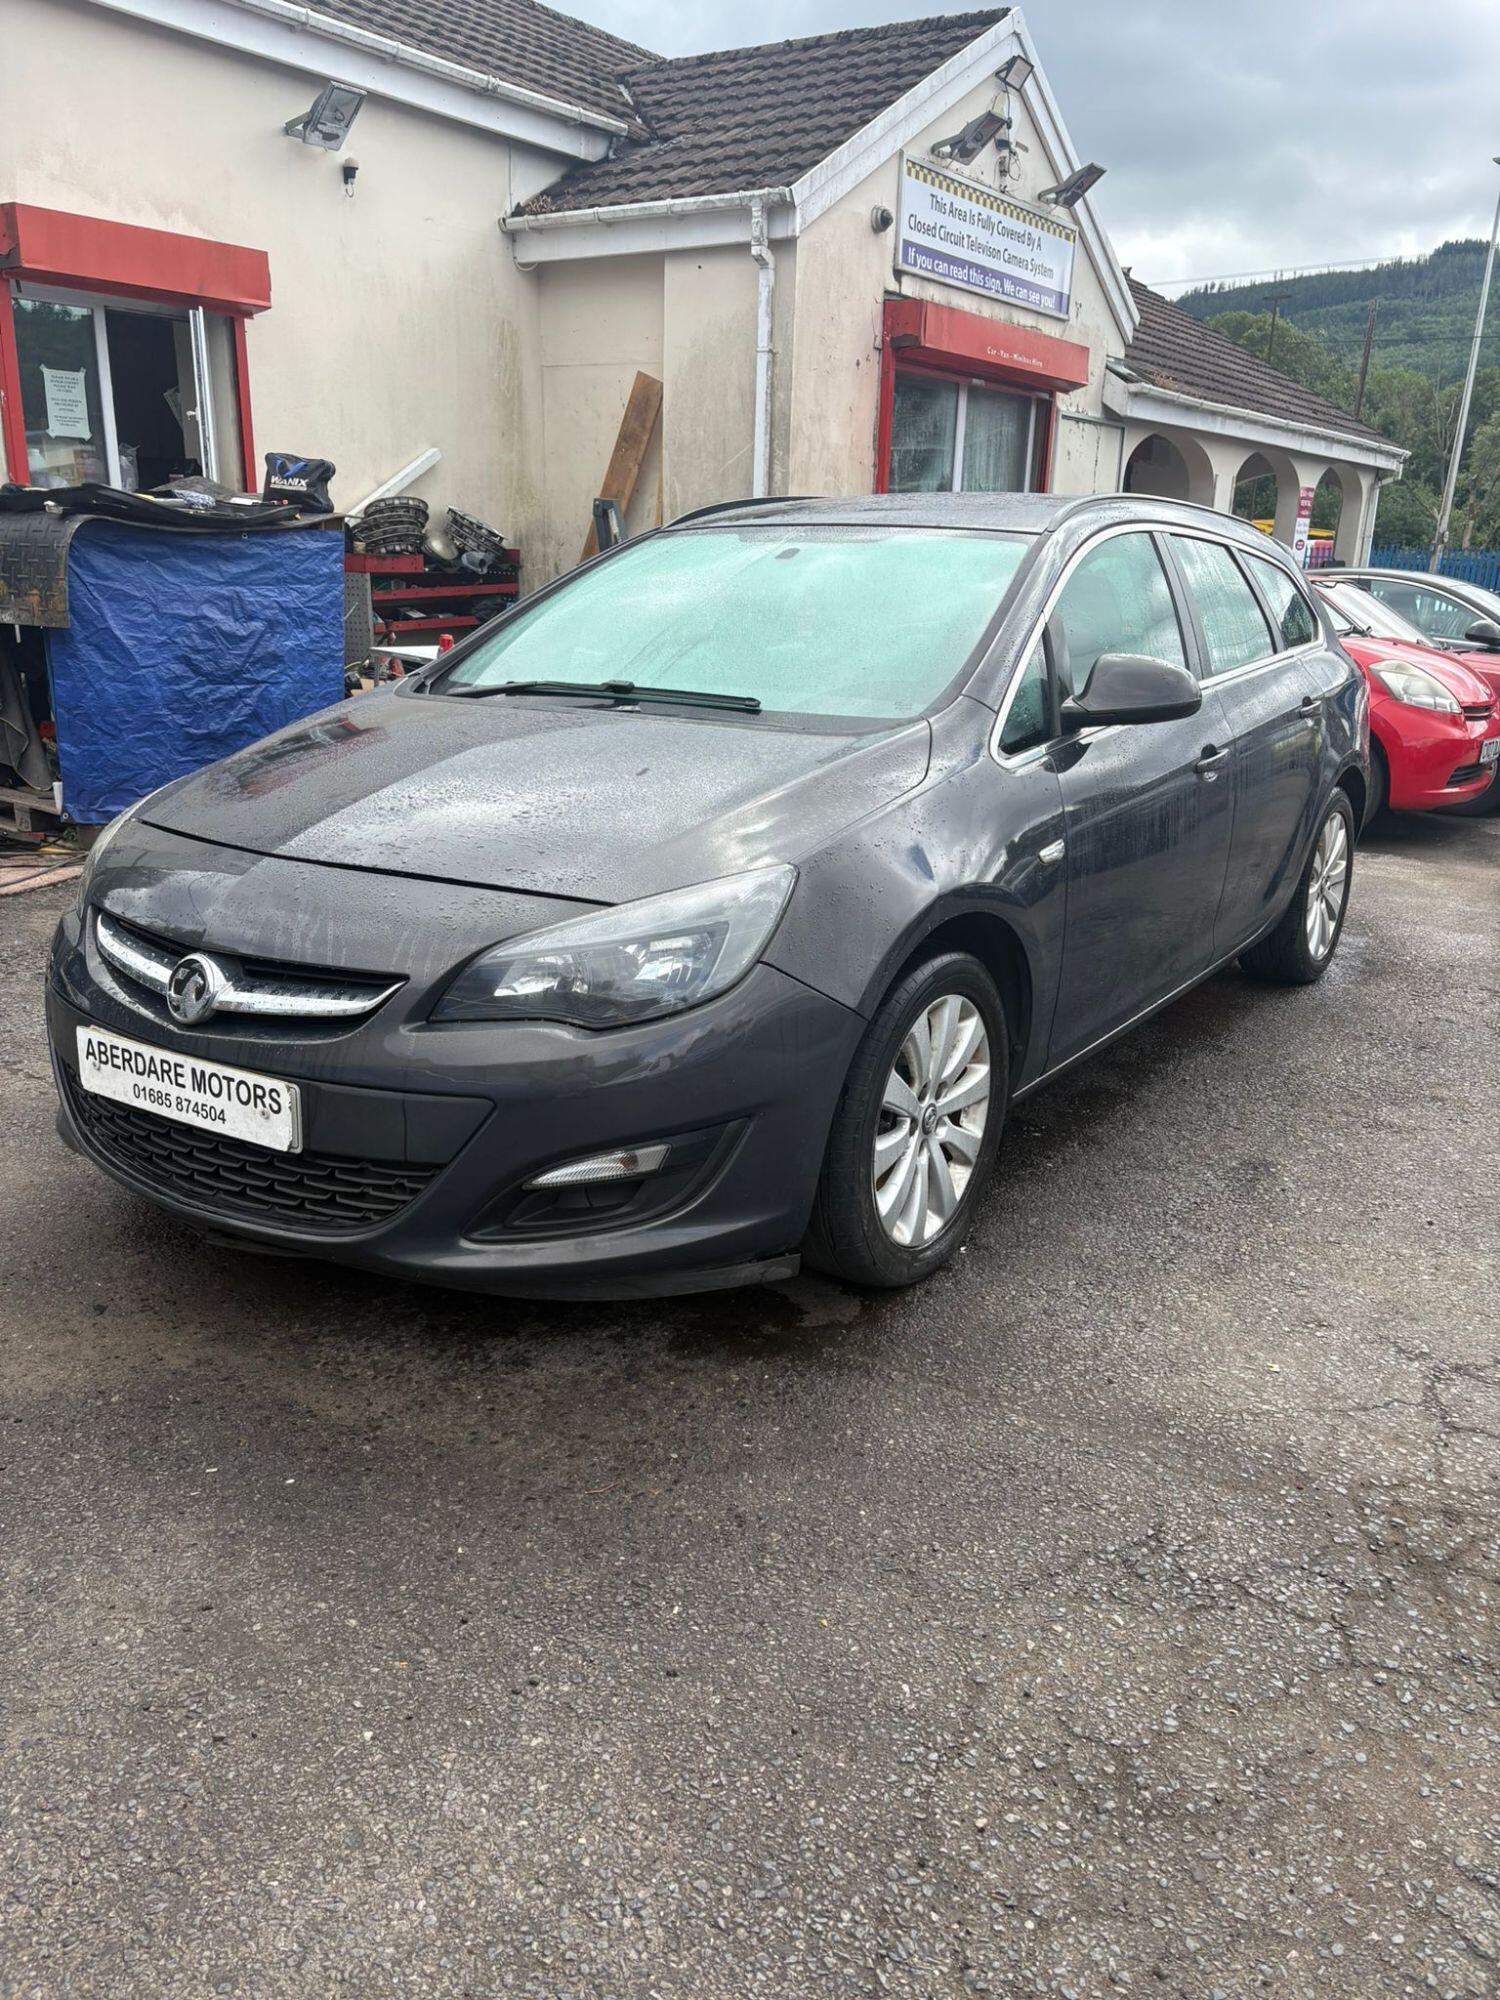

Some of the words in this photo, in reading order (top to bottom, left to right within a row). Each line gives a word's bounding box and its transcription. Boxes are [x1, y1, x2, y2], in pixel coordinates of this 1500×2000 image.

[908, 213, 937, 239] Closed
[938, 225, 965, 249] Circuit
[1002, 248, 1029, 272] Camera
[1029, 257, 1054, 280] System
[930, 193, 947, 215] This
[948, 201, 967, 223] Area
[969, 209, 976, 226] Is
[977, 212, 996, 237] Fully
[996, 220, 1026, 245] Covered
[1027, 231, 1036, 252] By
[1036, 235, 1042, 252] A
[908, 246, 916, 265] If
[916, 252, 933, 270] you
[933, 259, 949, 276] can
[949, 264, 969, 282] read
[969, 267, 984, 287] this
[1003, 277, 1015, 297] We
[1015, 285, 1028, 300] can
[1028, 290, 1040, 304] see
[1040, 294, 1056, 309] you!
[86, 1038, 187, 1089] ABERDARE
[191, 1067, 282, 1115] MOTORS
[133, 1083, 172, 1109] 01685
[175, 1096, 227, 1125] 874504
